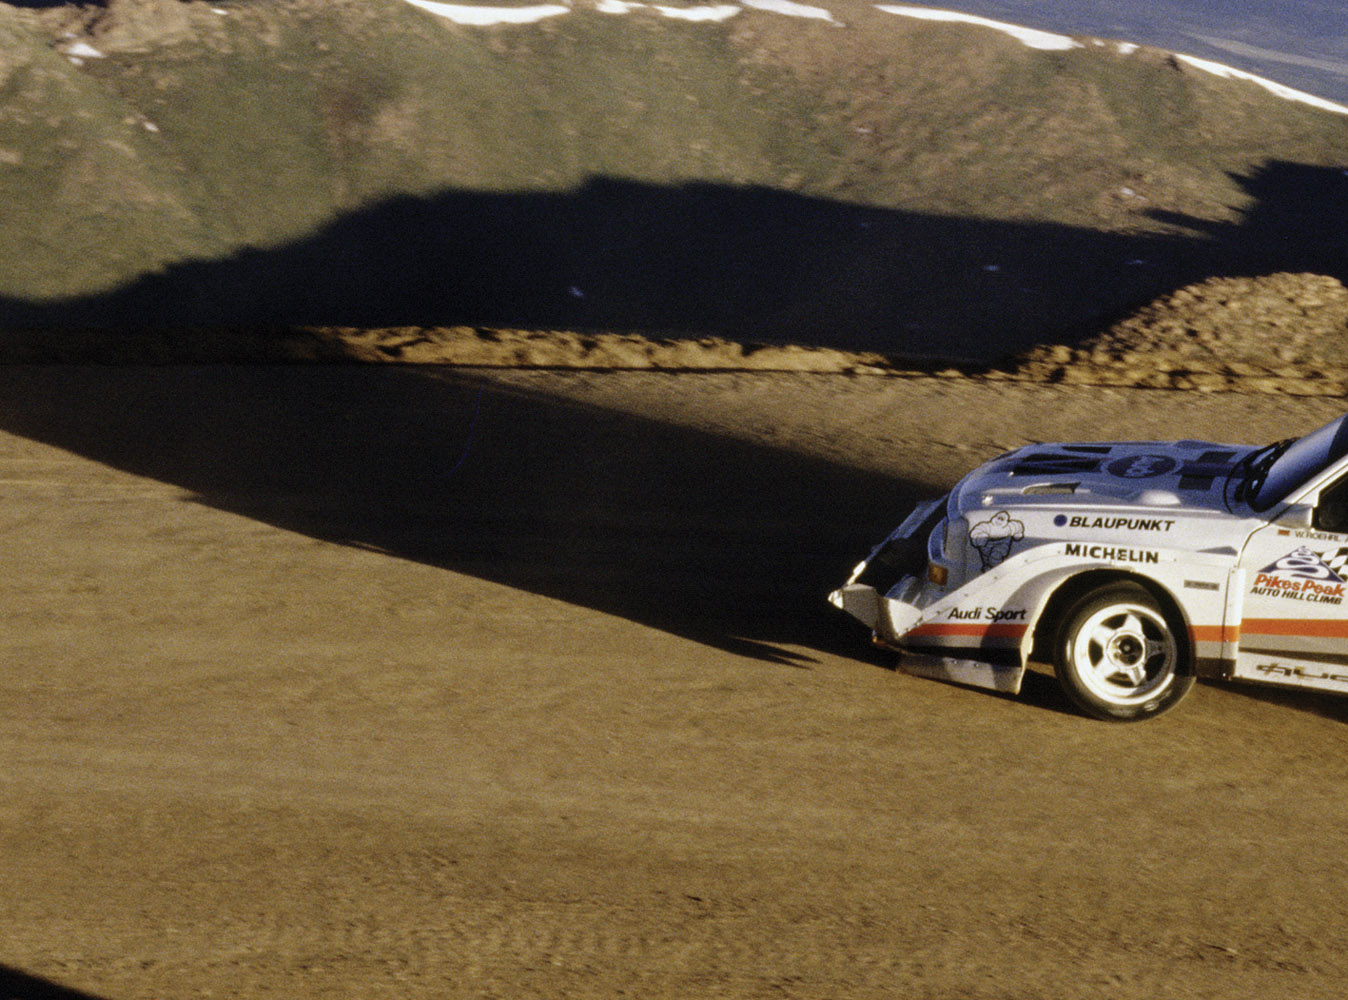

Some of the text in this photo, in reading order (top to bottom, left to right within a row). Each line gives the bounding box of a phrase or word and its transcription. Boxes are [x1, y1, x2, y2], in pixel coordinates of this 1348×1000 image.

[1069, 516, 1175, 532] BLAUPUNKT
[1065, 543, 1159, 564] MICHELIN
[1254, 573, 1347, 598] Pikes Peak
[1250, 586, 1343, 605] AUTO HILL CLIMB
[947, 606, 1027, 623] Audi Sport
